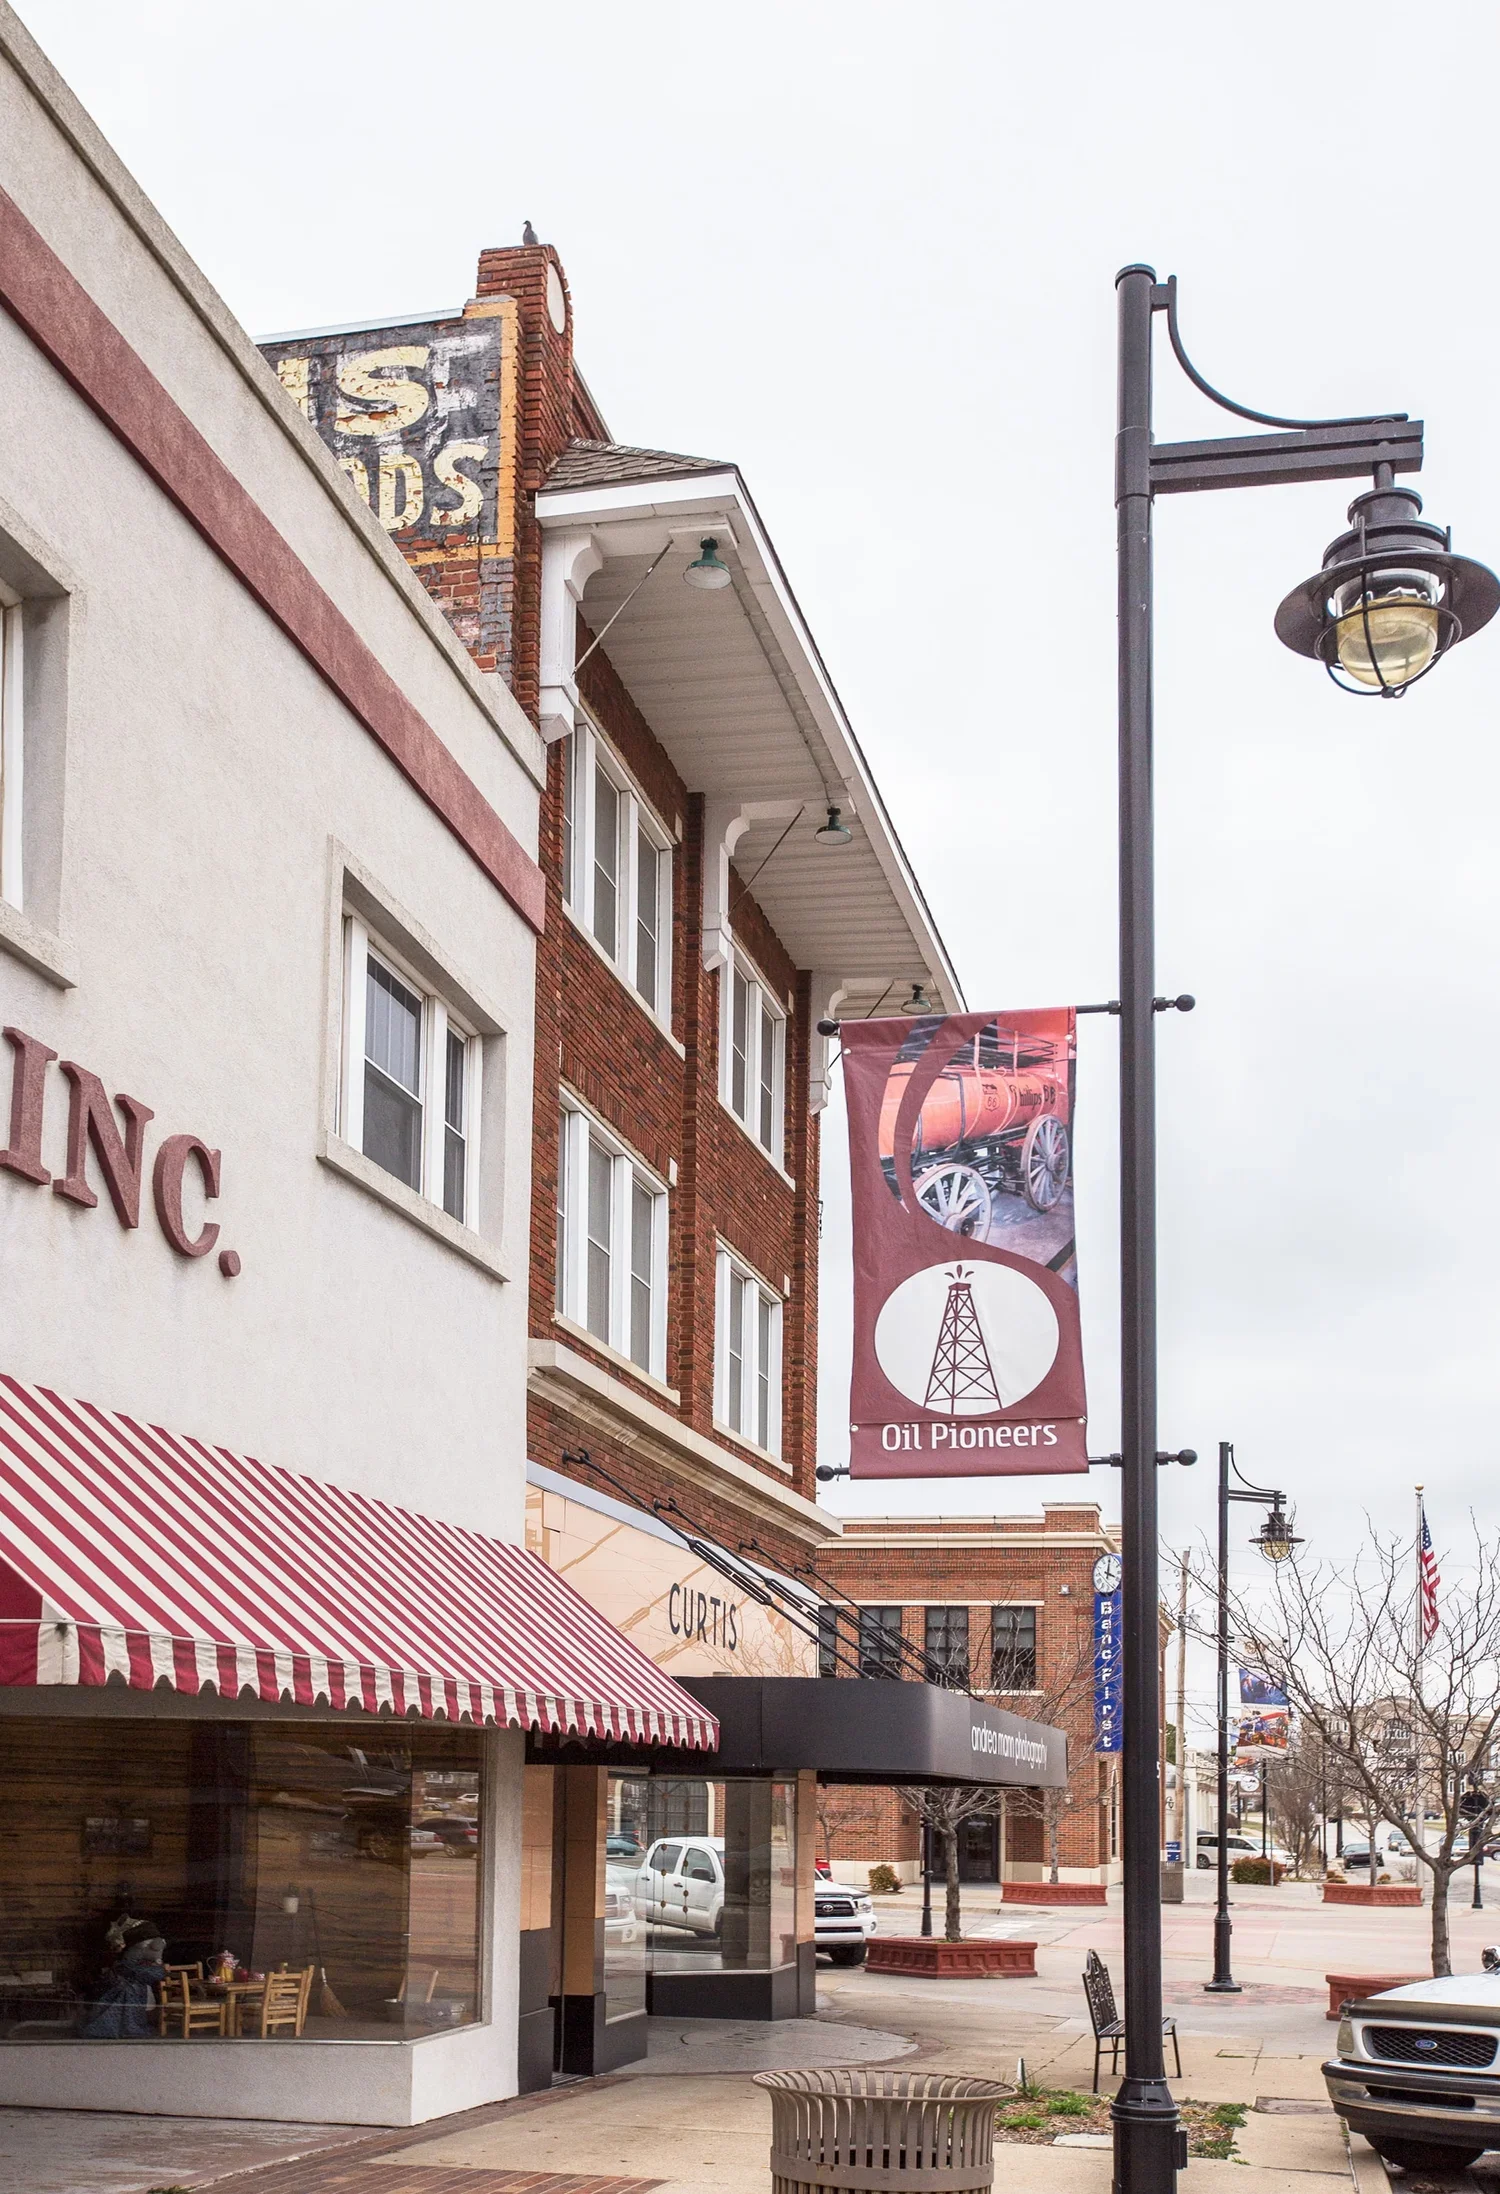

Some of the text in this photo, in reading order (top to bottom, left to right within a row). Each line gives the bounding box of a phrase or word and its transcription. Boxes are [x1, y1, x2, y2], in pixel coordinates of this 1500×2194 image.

[987, 1096, 997, 1108] 66
[1, 1026, 241, 1277] INC.
[882, 1422, 1058, 1451] Oil Pioneers
[669, 1582, 737, 1651] CURTIS
[971, 1720, 997, 1755] andrea
[1015, 1731, 1048, 1771] photography
